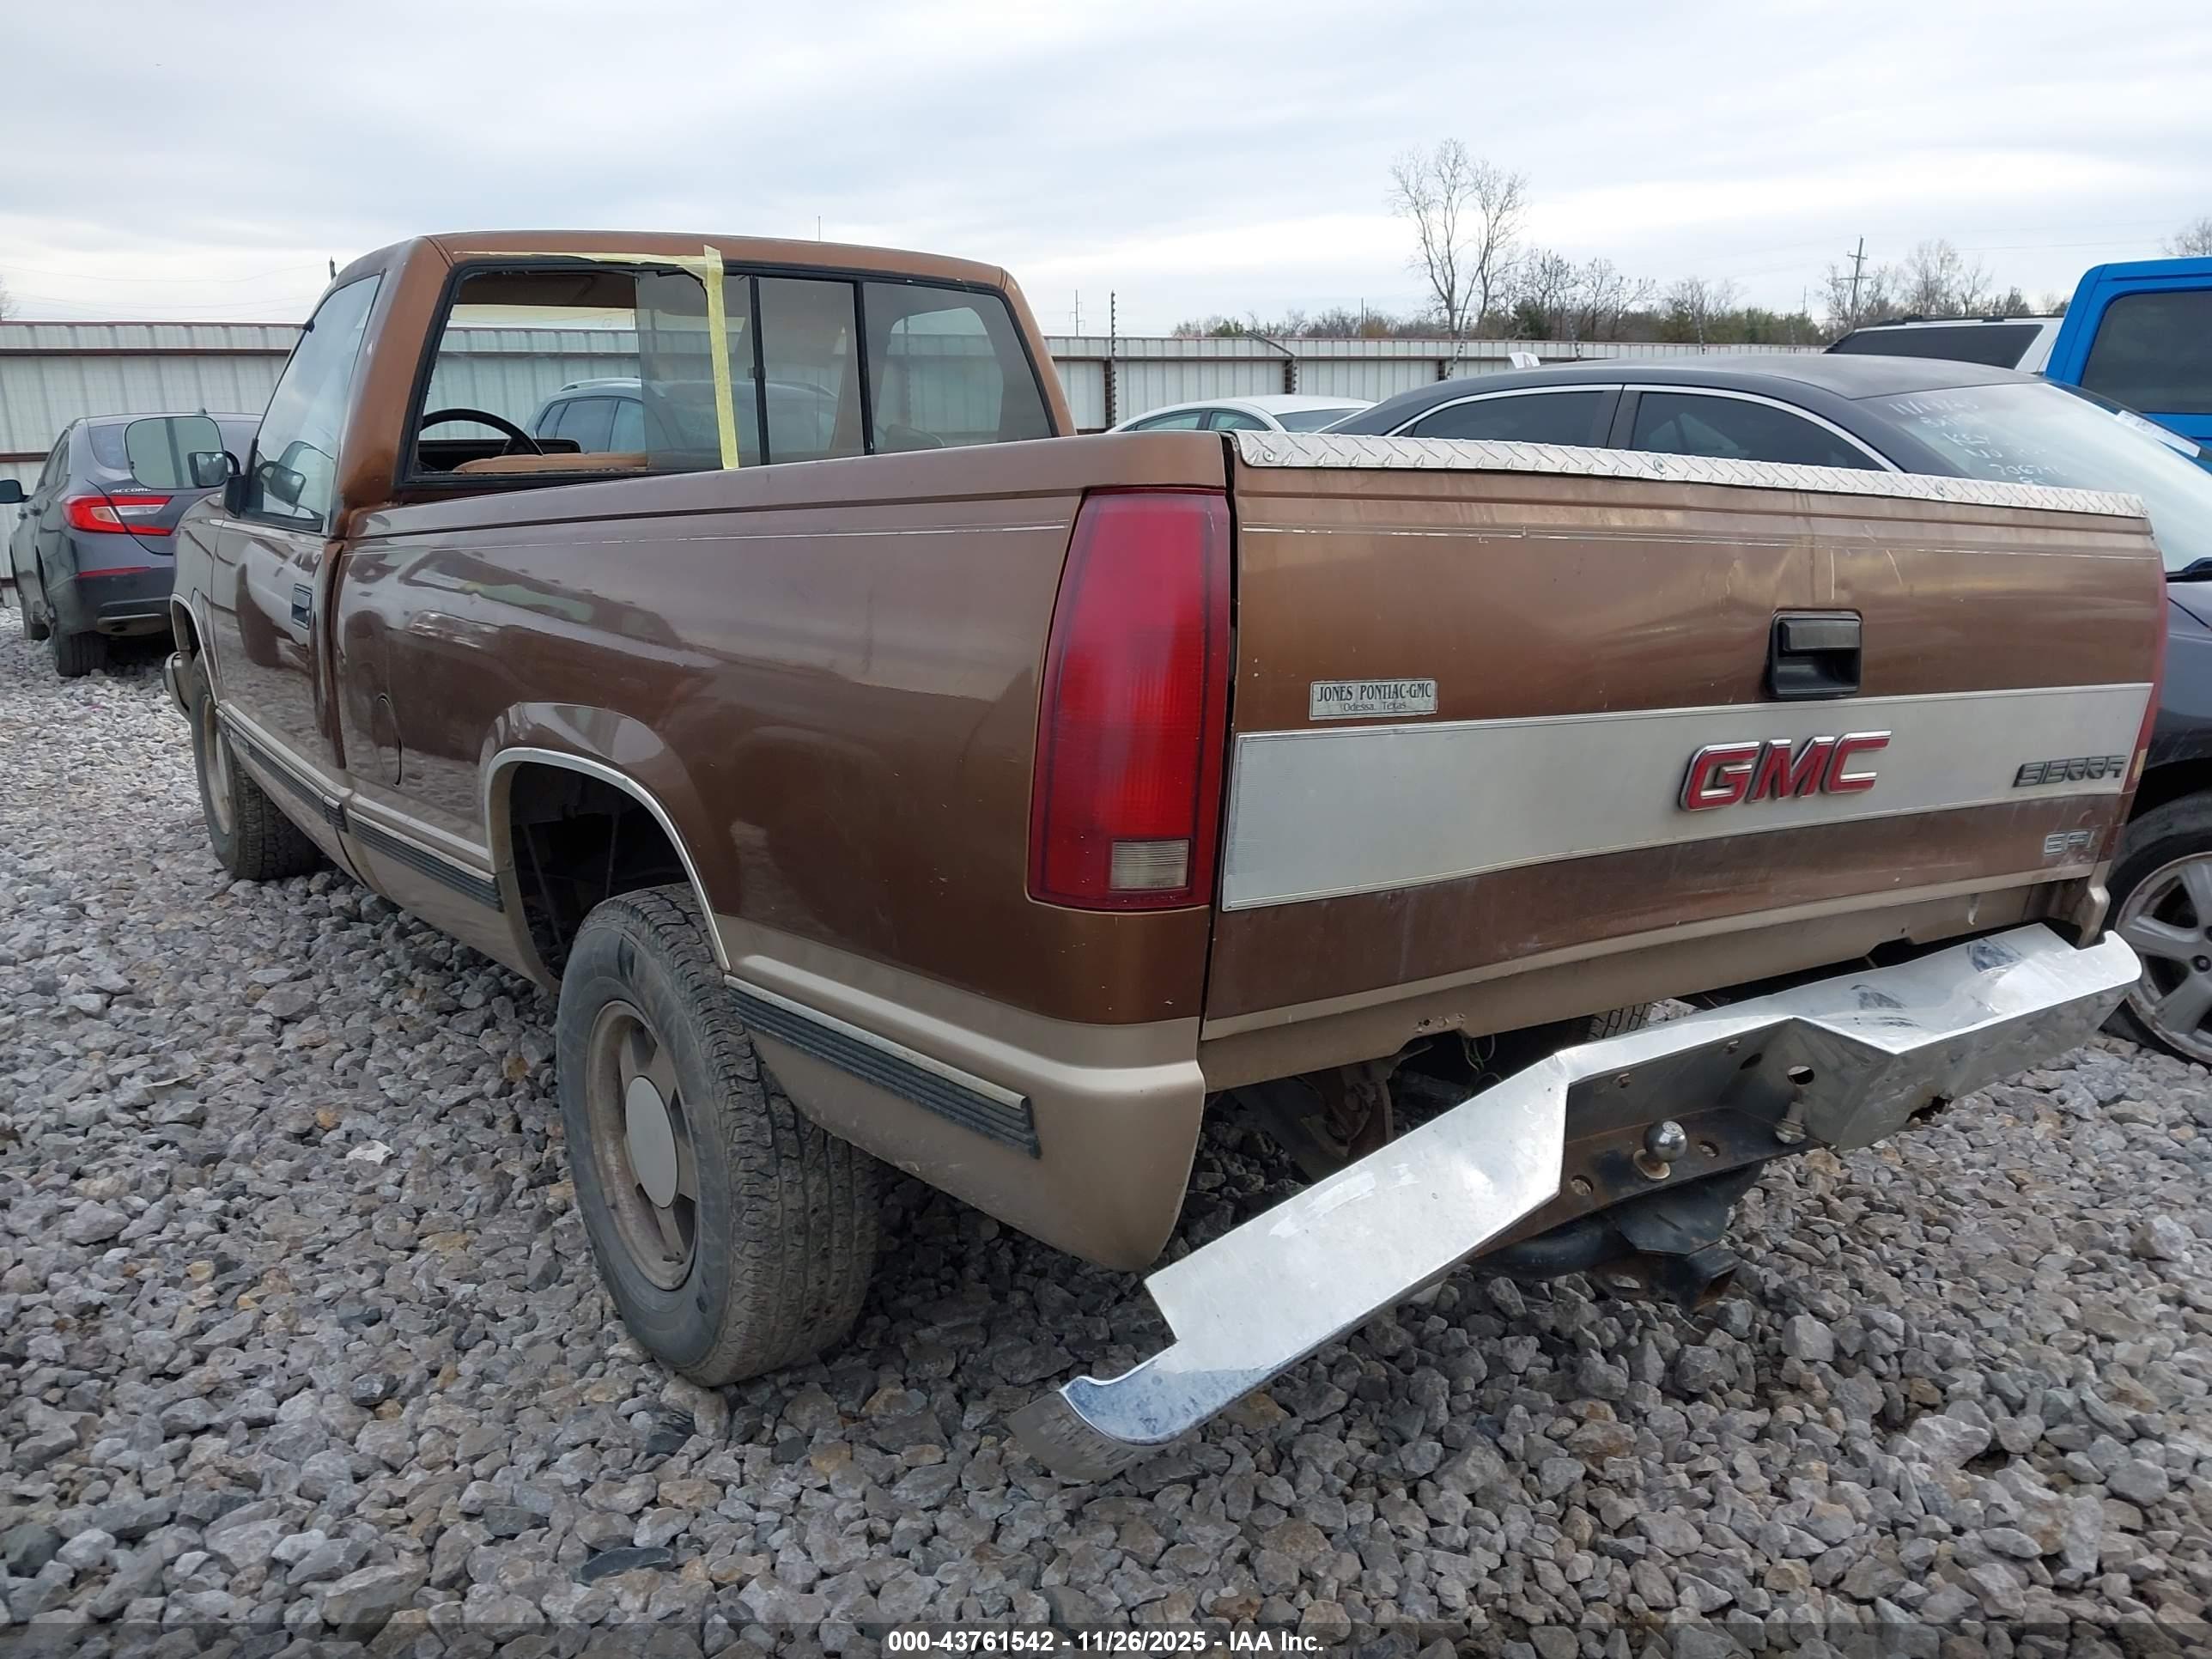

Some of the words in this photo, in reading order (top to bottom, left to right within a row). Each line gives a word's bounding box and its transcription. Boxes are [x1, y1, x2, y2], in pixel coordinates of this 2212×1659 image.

[1316, 685, 1353, 702] JONES
[1382, 701, 1407, 710] Texas
[1679, 730, 1893, 811] GMC
[2012, 755, 2126, 787] SIERRA
